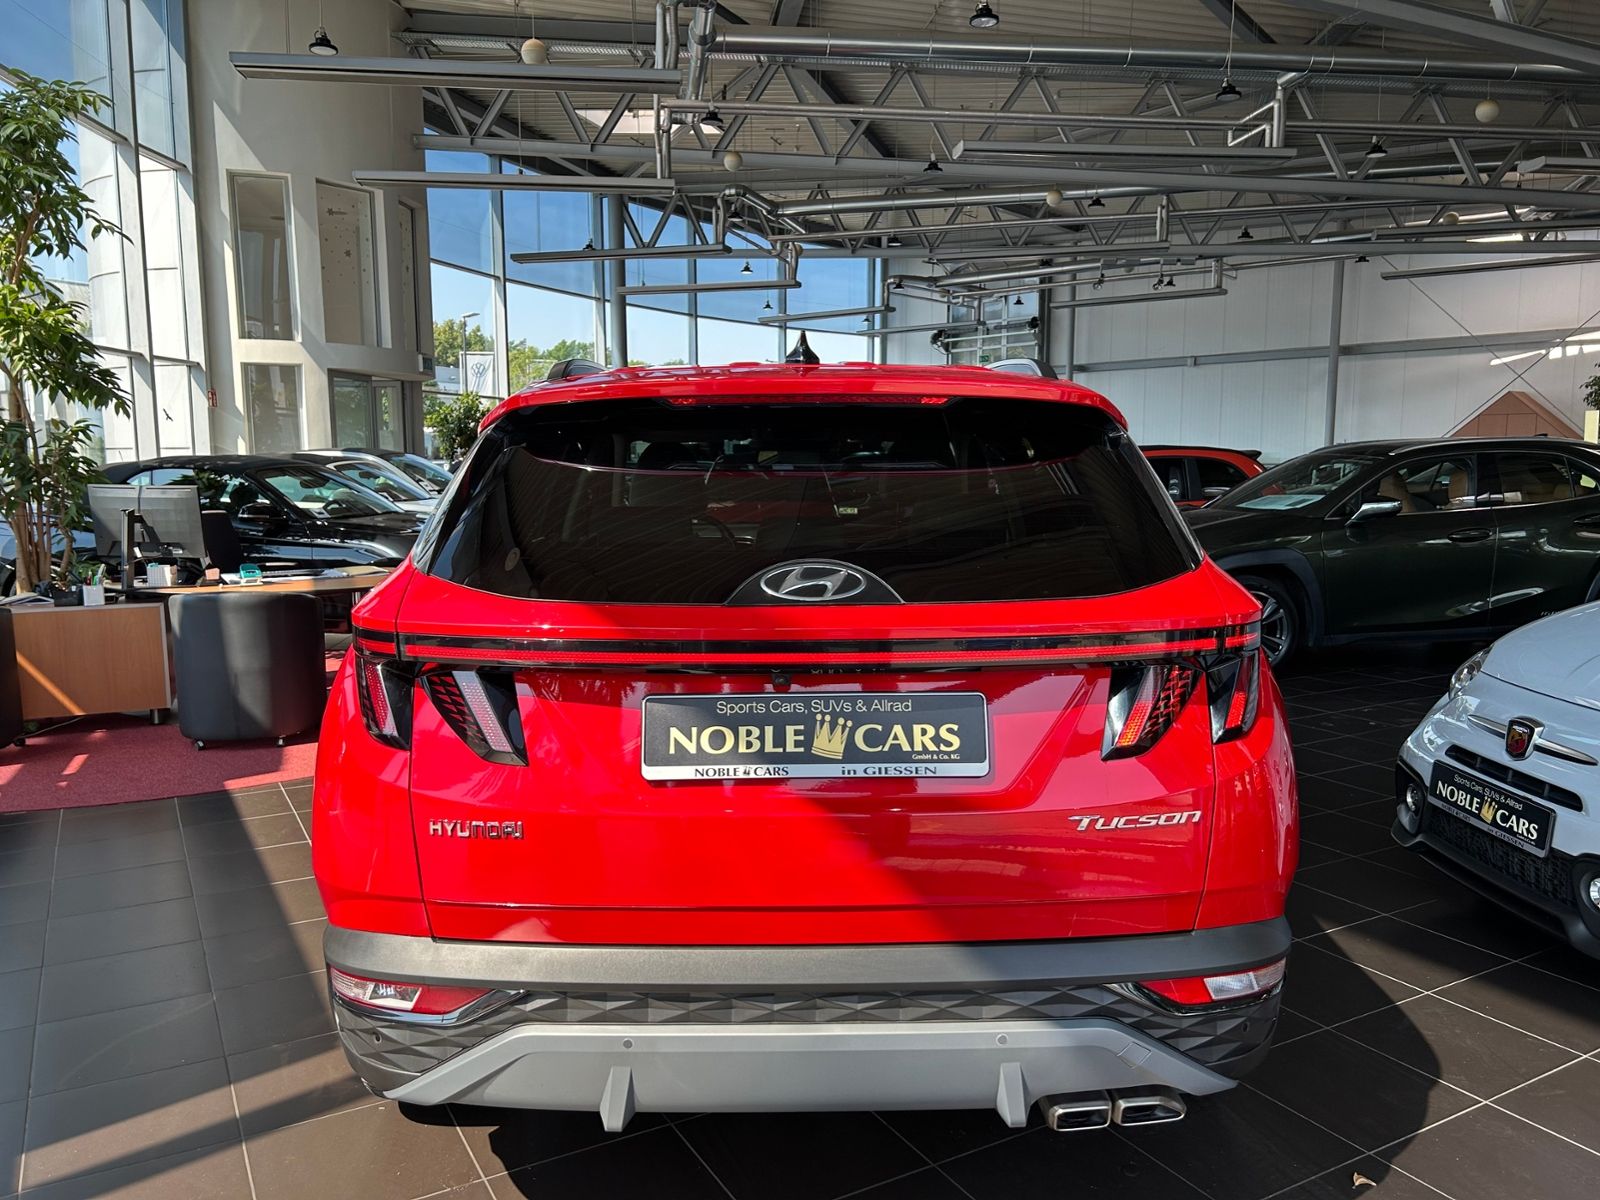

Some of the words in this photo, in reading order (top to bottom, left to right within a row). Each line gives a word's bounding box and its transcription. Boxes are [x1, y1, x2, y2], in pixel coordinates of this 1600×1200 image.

[716, 700, 765, 716] Sports
[769, 700, 808, 714] Cars,
[811, 699, 853, 713] SUVs
[856, 699, 868, 713] &
[870, 699, 912, 712] Allrad
[668, 724, 805, 755] NOBLE
[854, 723, 961, 753] CARS
[694, 767, 740, 777] NOBLE
[753, 766, 789, 777] CARS
[841, 766, 857, 776] in
[863, 766, 937, 776] GIESSEN
[1453, 774, 1470, 788] Sports
[1484, 788, 1500, 801] SUVs
[1505, 798, 1523, 810] Allrad
[1436, 780, 1481, 814] NOBLE
[1496, 809, 1538, 840] CARS
[429, 819, 523, 838] HYUNDAI
